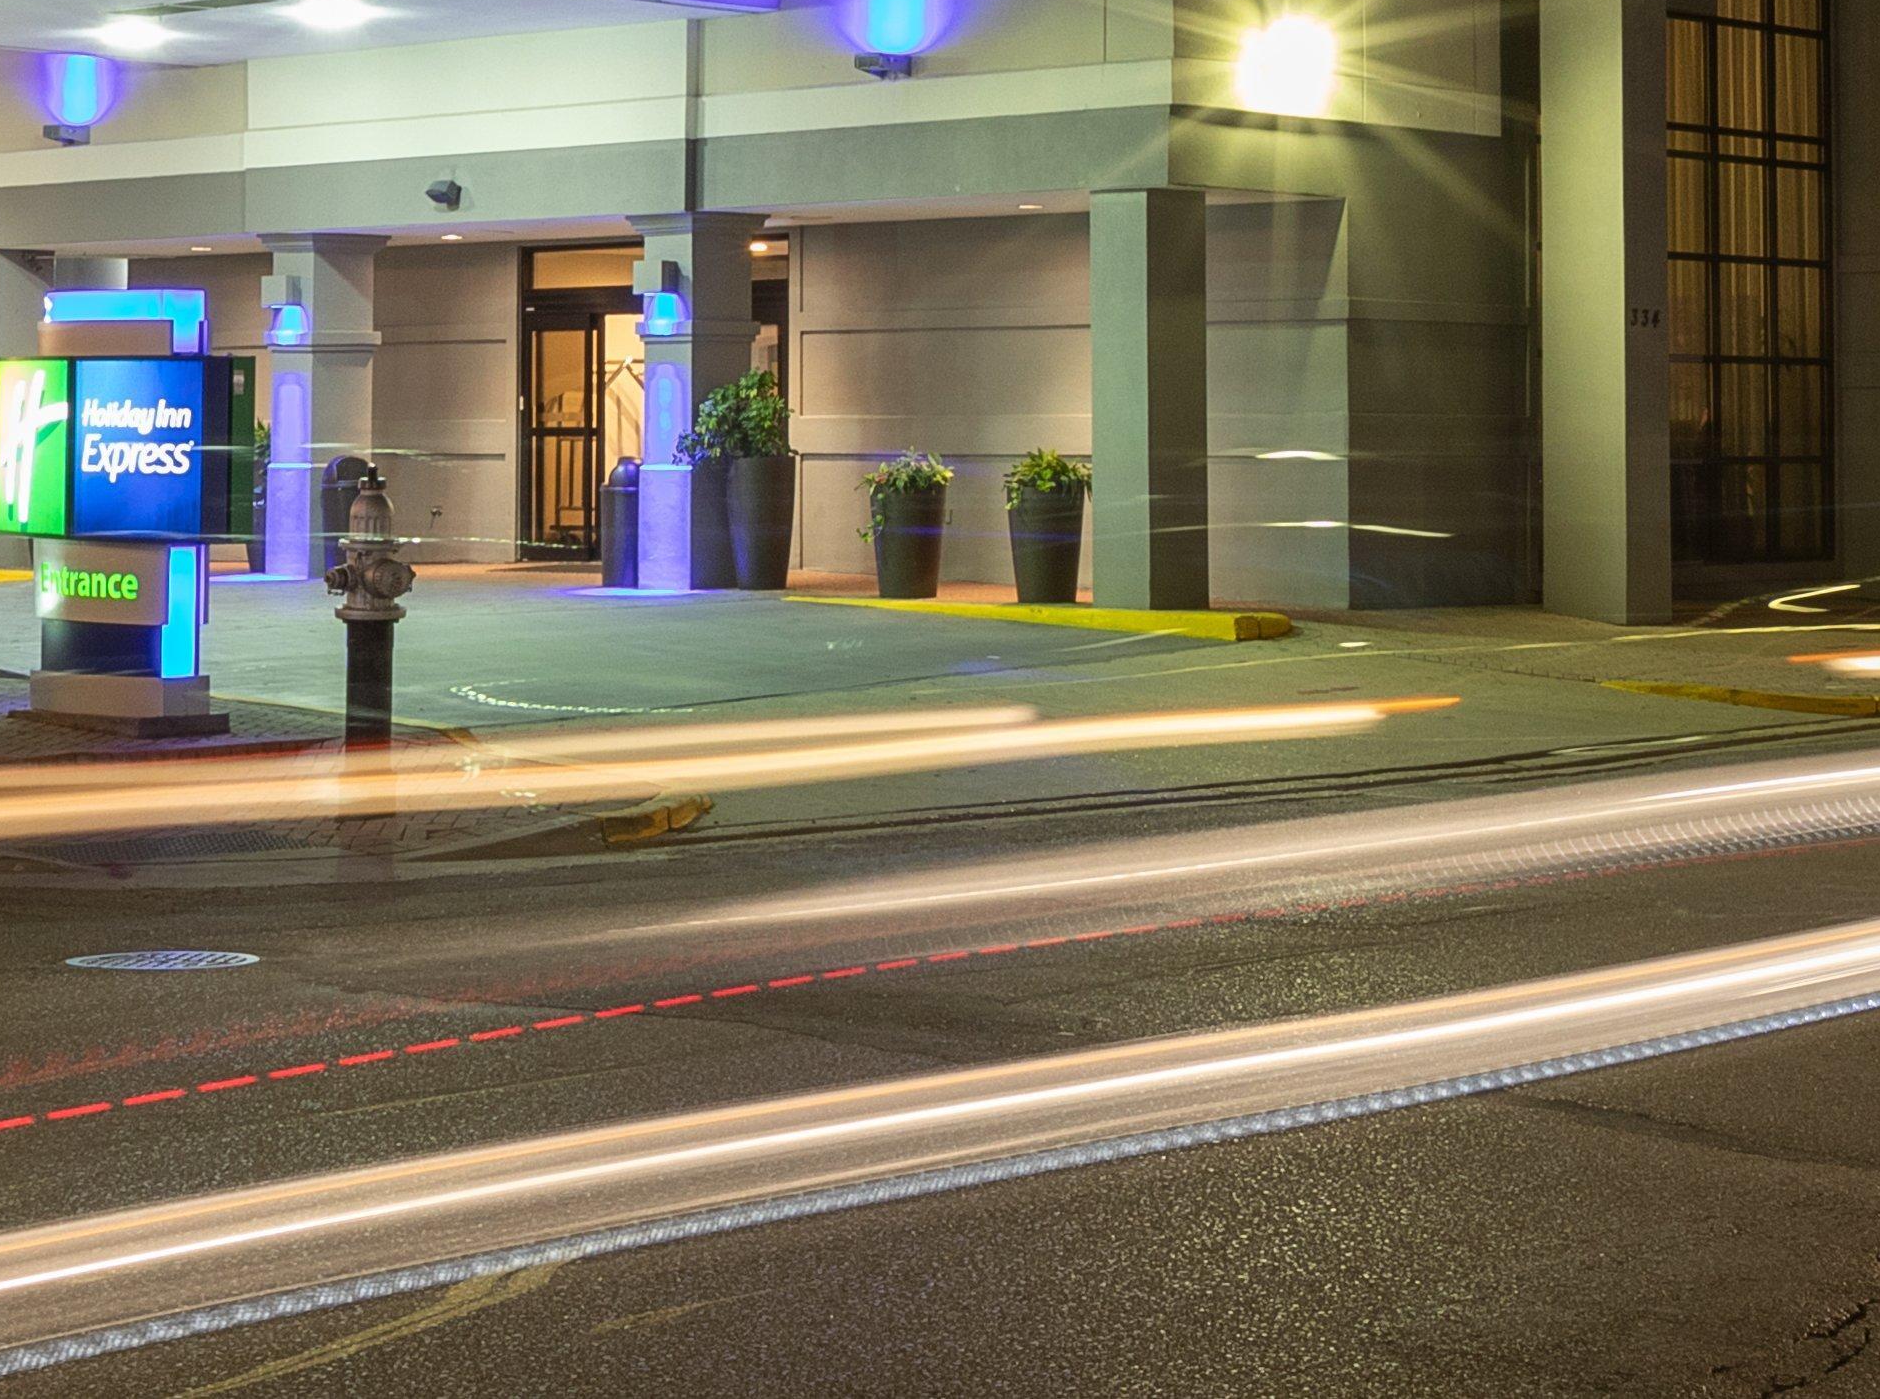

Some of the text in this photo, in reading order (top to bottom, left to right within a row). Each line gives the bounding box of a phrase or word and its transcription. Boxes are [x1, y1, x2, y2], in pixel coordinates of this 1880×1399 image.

[82, 398, 192, 435] Holiday Inn
[81, 433, 191, 483] Express
[40, 561, 139, 600] Entrance
